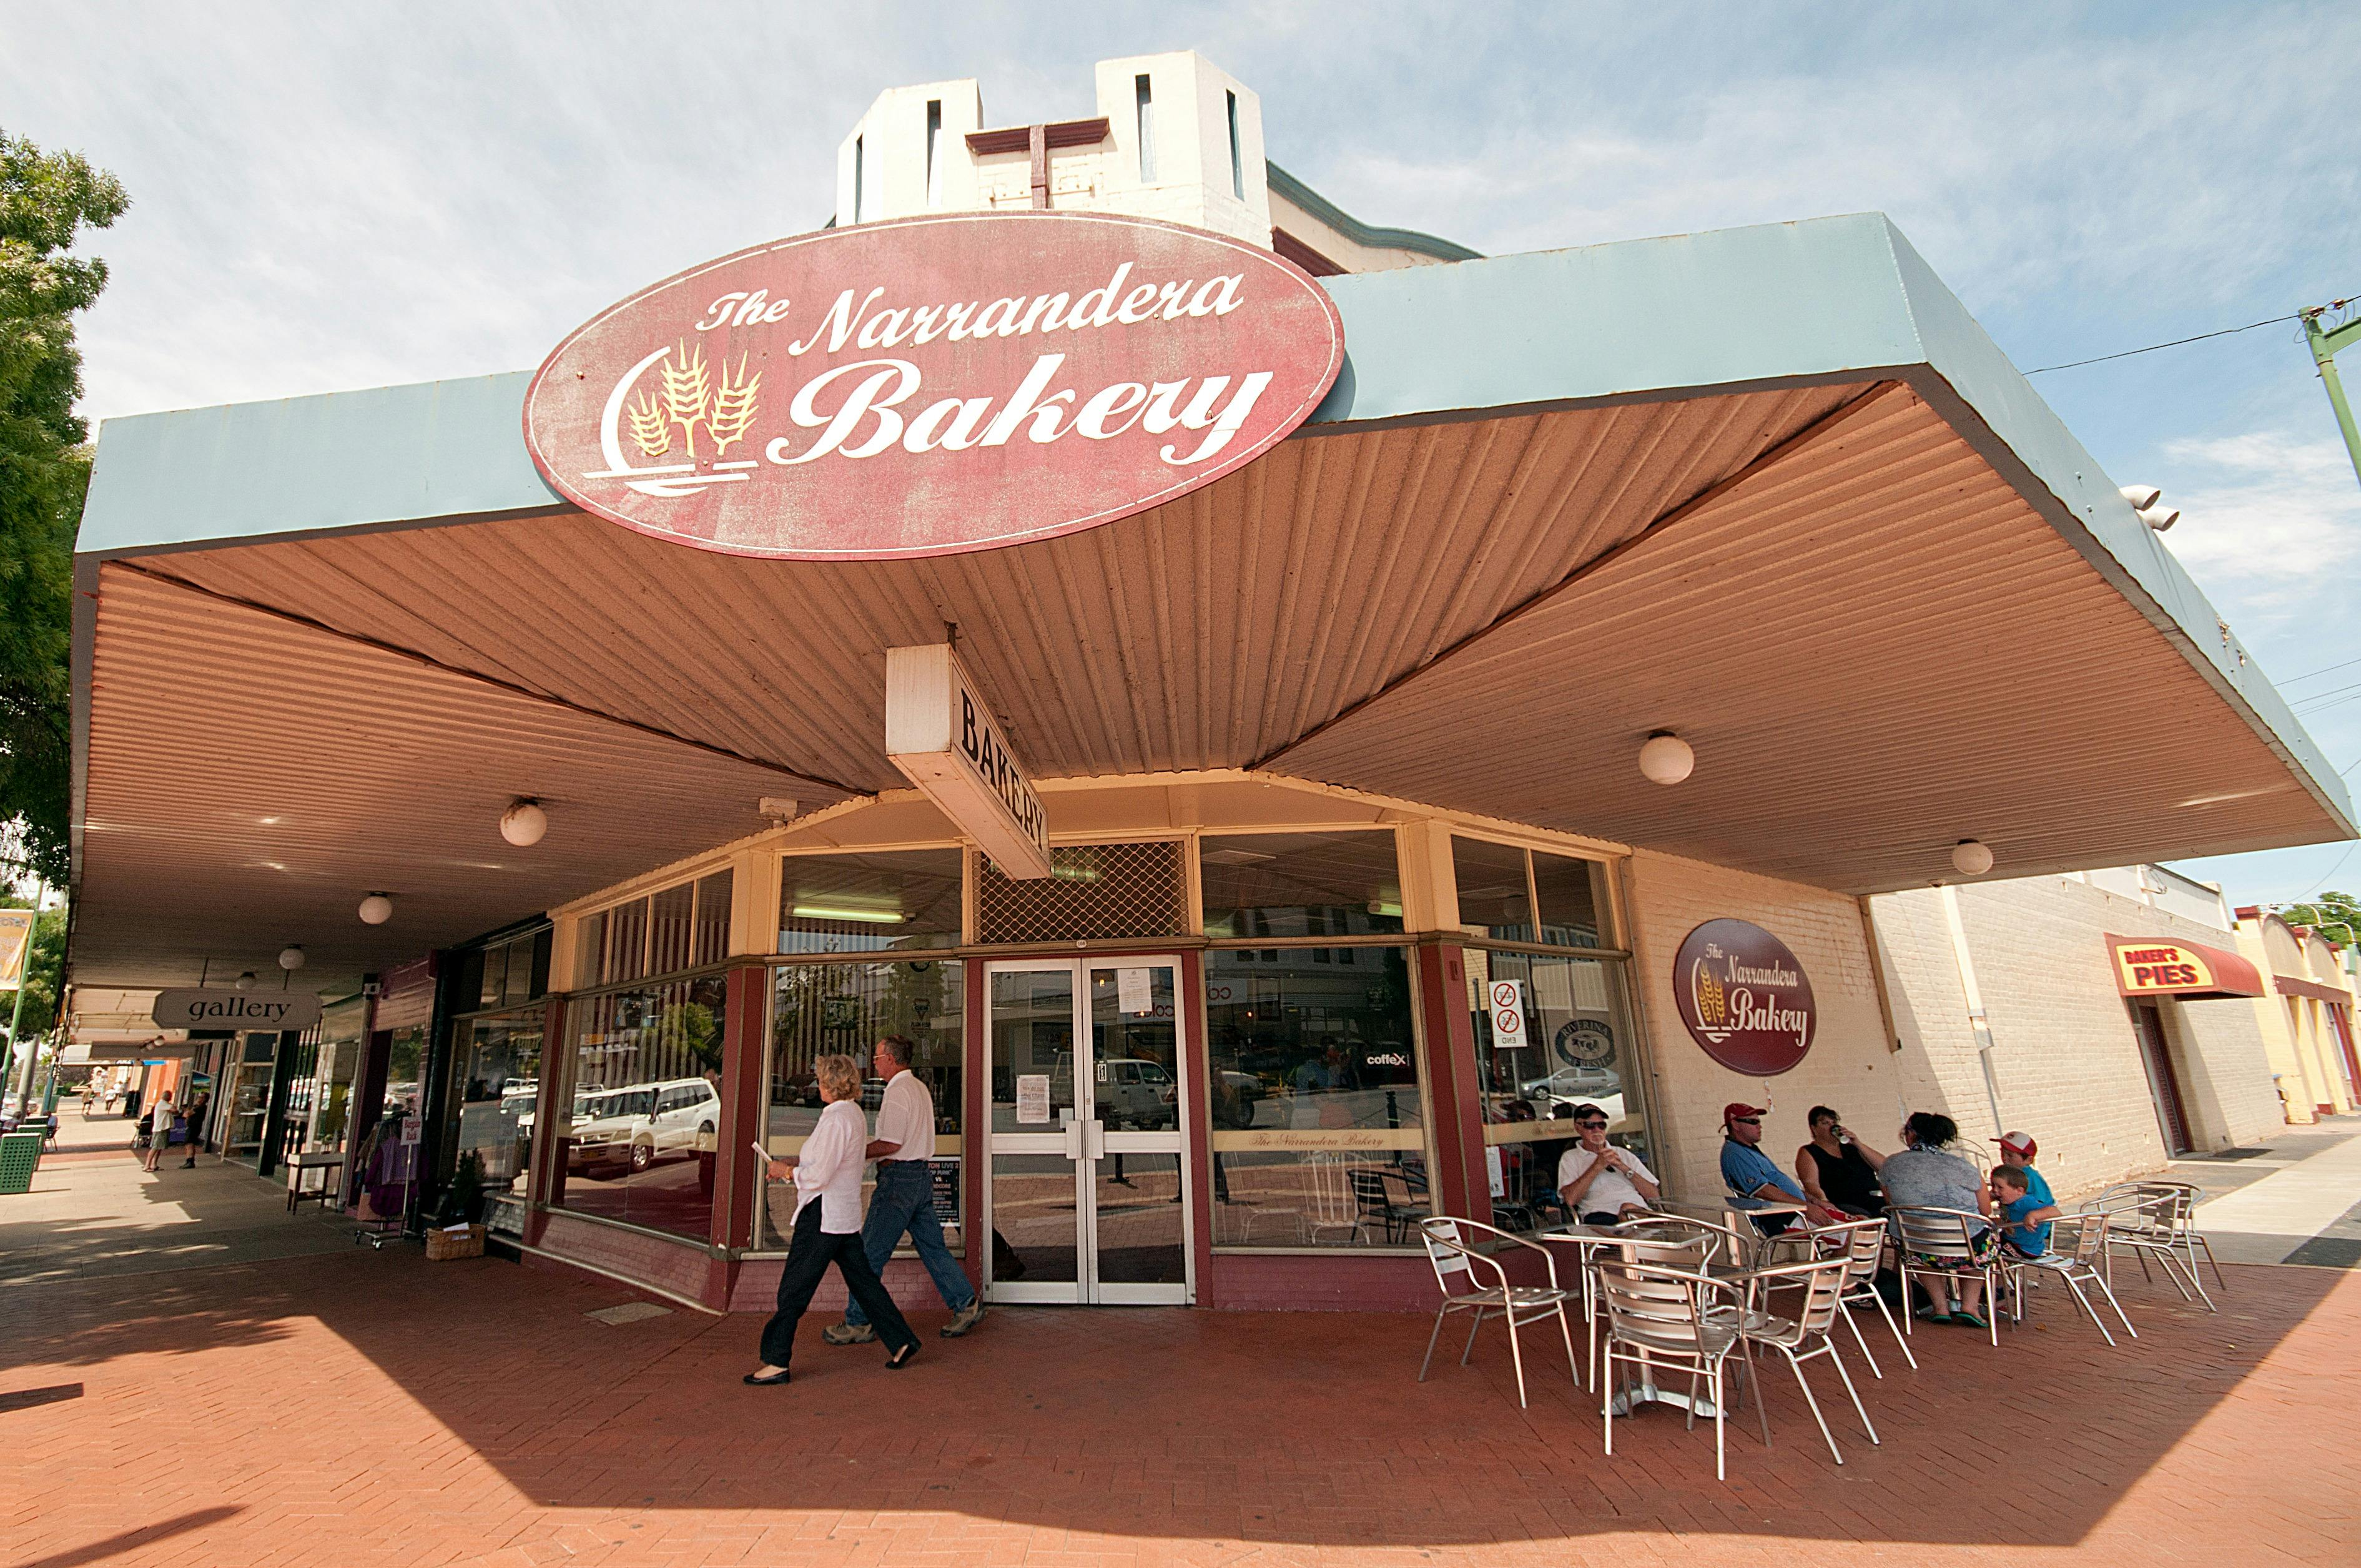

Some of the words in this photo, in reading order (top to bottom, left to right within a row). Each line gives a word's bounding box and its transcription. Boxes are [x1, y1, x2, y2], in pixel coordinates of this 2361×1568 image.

[695, 288, 791, 332] The
[787, 261, 1245, 357] Narrandera
[767, 353, 1274, 466] Bakery
[960, 688, 1044, 852] BAKERY
[1705, 943, 1723, 959] The
[2124, 948, 2179, 964] BAKER'S
[1725, 955, 1798, 987] Narrandera
[2133, 964, 2199, 987] PIES
[189, 997, 292, 1022] gallery
[1730, 987, 1808, 1047] Bakery
[1562, 1020, 1609, 1037] RIVERINA
[1574, 1057, 1607, 1068] FRESH
[1250, 1133, 1271, 1146] The
[1276, 1133, 1338, 1146] Narrandera
[1343, 1132, 1384, 1146] Bakery
